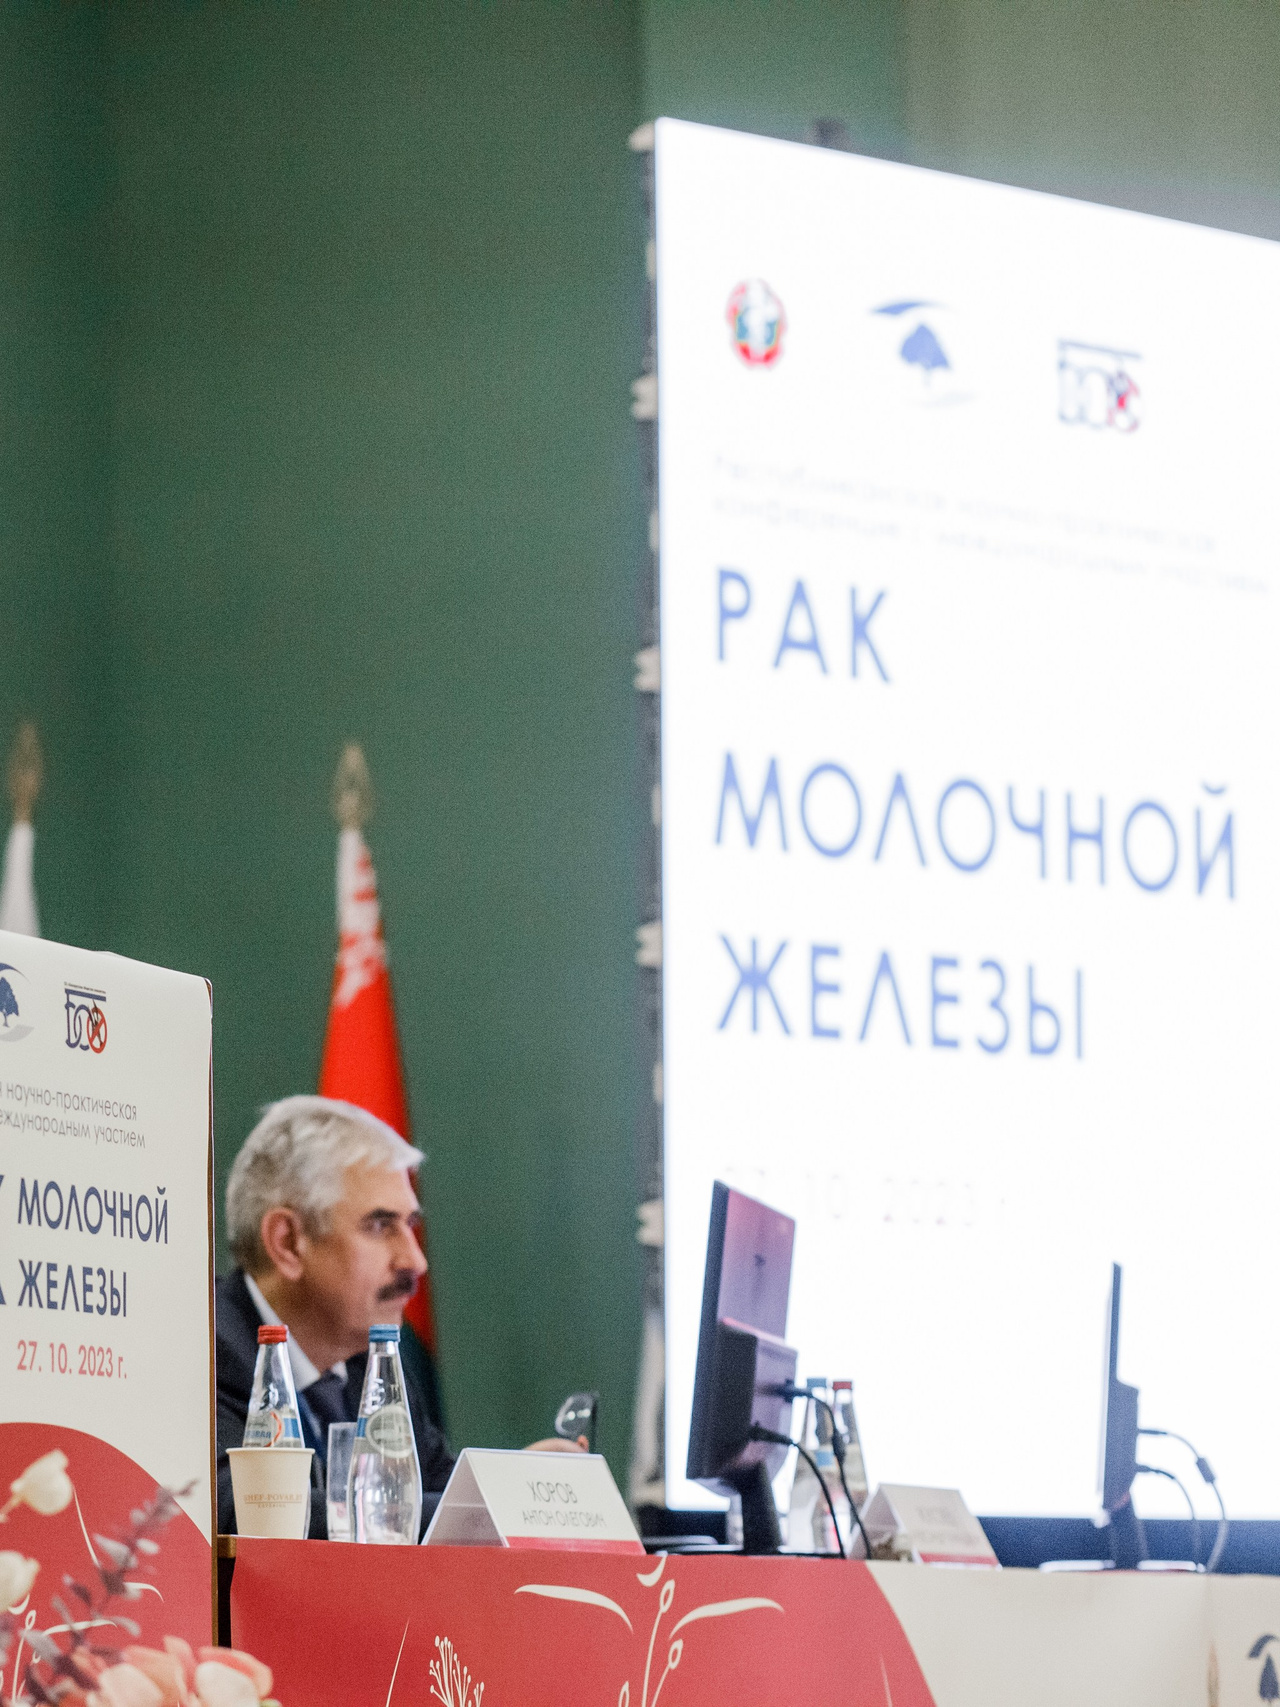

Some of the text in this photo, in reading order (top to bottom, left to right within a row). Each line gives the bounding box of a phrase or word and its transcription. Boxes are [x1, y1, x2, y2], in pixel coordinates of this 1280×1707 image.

[716, 567, 890, 685] РАК
[715, 750, 1235, 900] МОЛОЧНОЙ
[717, 933, 1084, 1061] ЖЕЛЕЗЫ
[7, 1081, 137, 1121] научно-практическая
[93, 1125, 146, 1149] участием
[17, 1177, 169, 1245] МОЛОЧНОЙ
[17, 1259, 127, 1318] ЖЕЛЕЗЫ
[17, 1339, 127, 1379] 27. 10. 2023 г.
[526, 1481, 578, 1504] ХОРОВ
